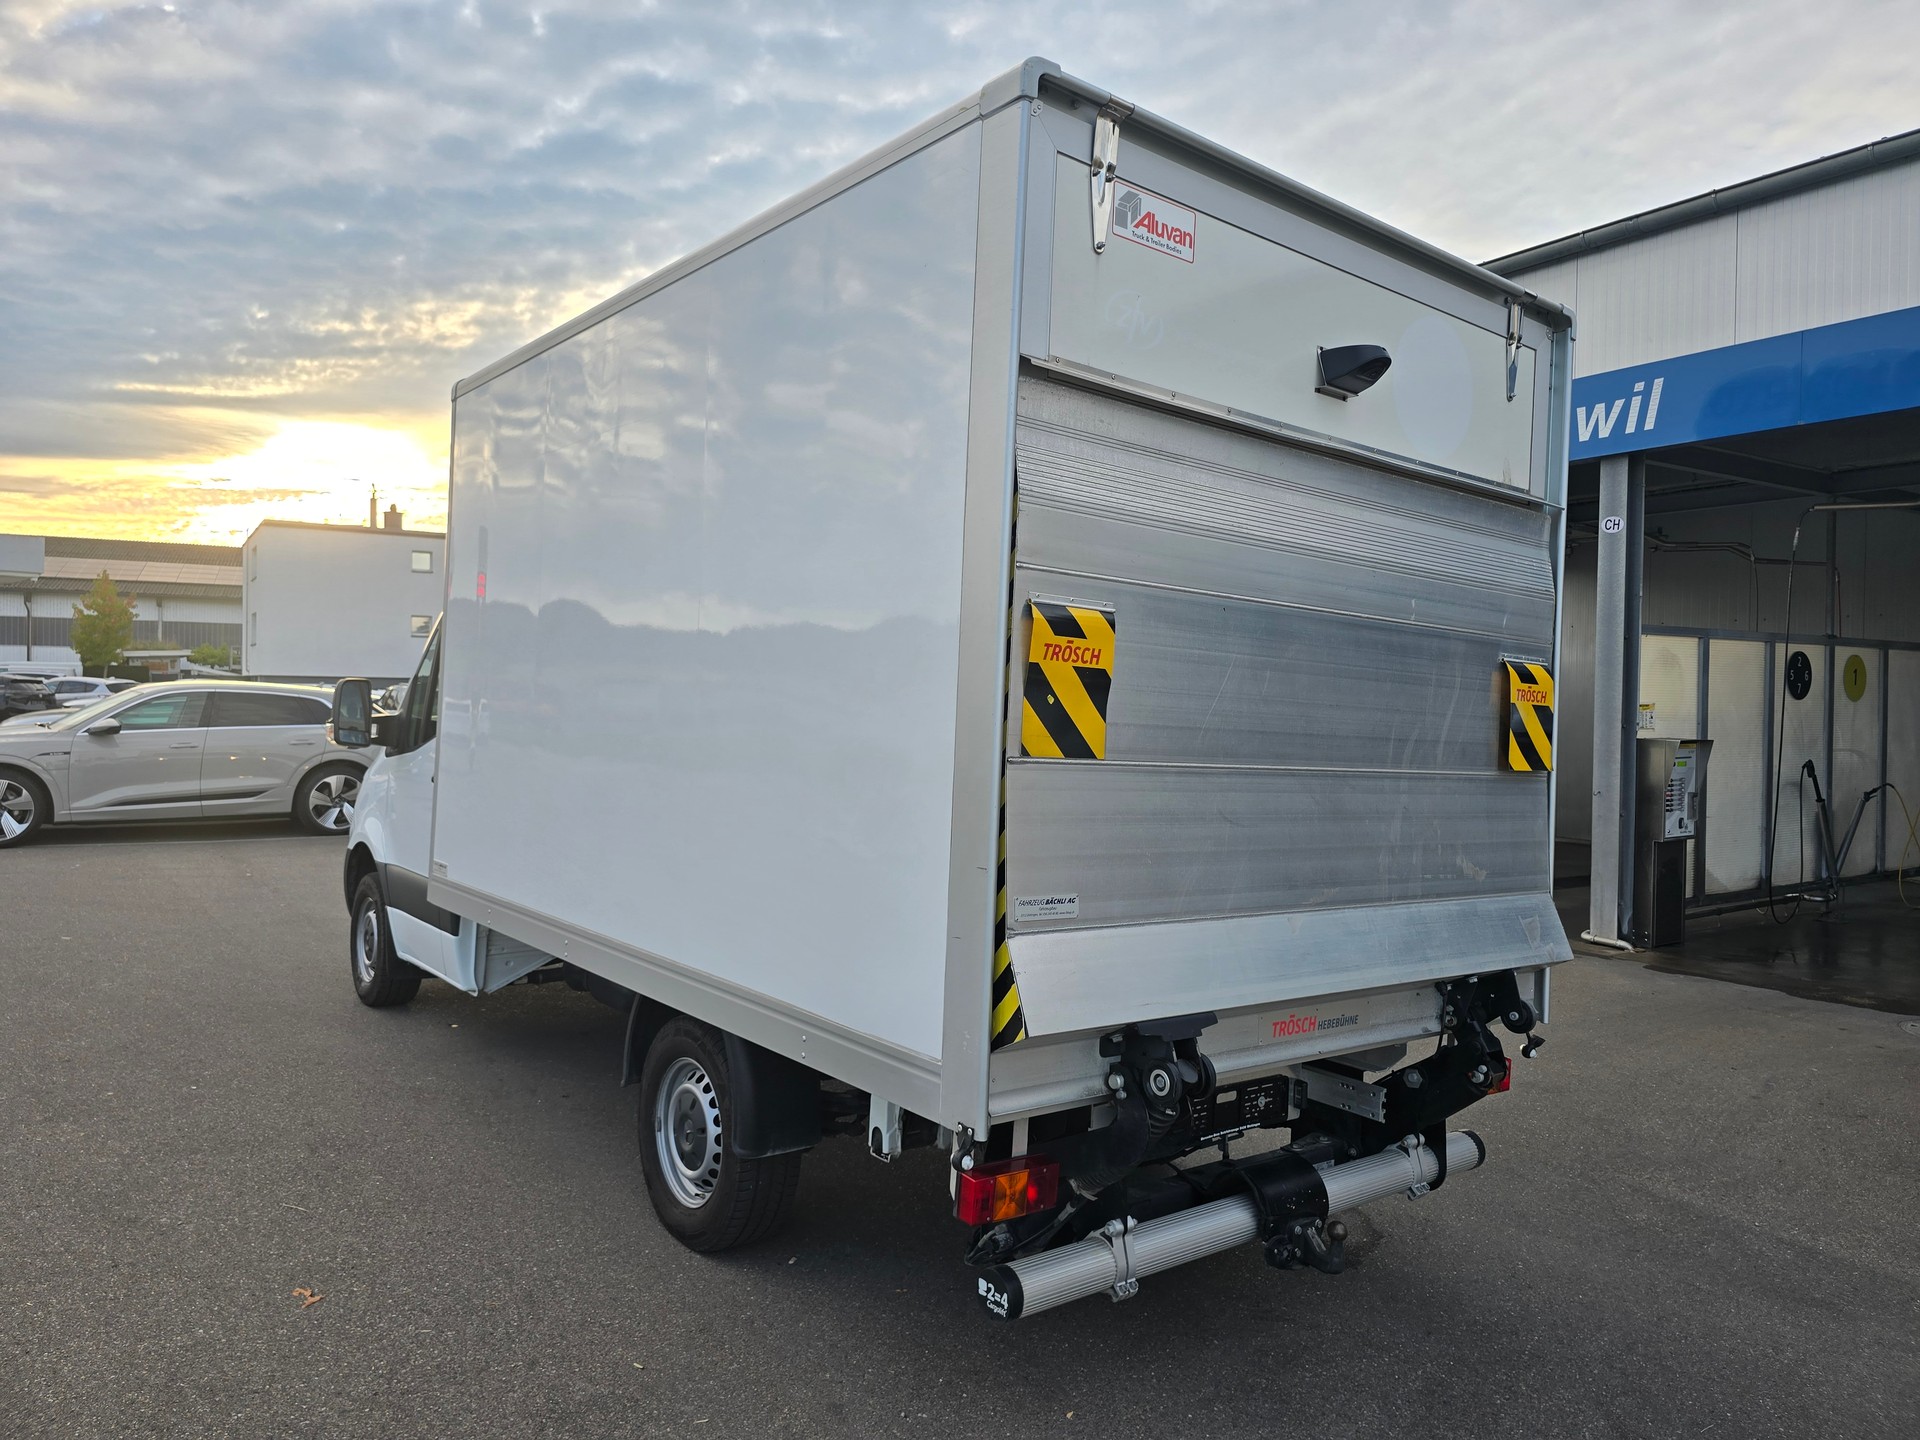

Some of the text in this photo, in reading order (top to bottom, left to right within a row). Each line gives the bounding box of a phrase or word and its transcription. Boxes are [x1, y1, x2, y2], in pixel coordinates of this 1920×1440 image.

[1133, 211, 1193, 249] Aluvan
[1132, 230, 1145, 241] Truck
[1150, 237, 1166, 248] Trailer
[1166, 243, 1182, 255] Bodies
[1604, 518, 1621, 531] CH
[1797, 656, 1802, 667] 2
[1790, 669, 1809, 681] 5 6
[1853, 668, 1858, 686] 1
[1797, 683, 1802, 694] 7
